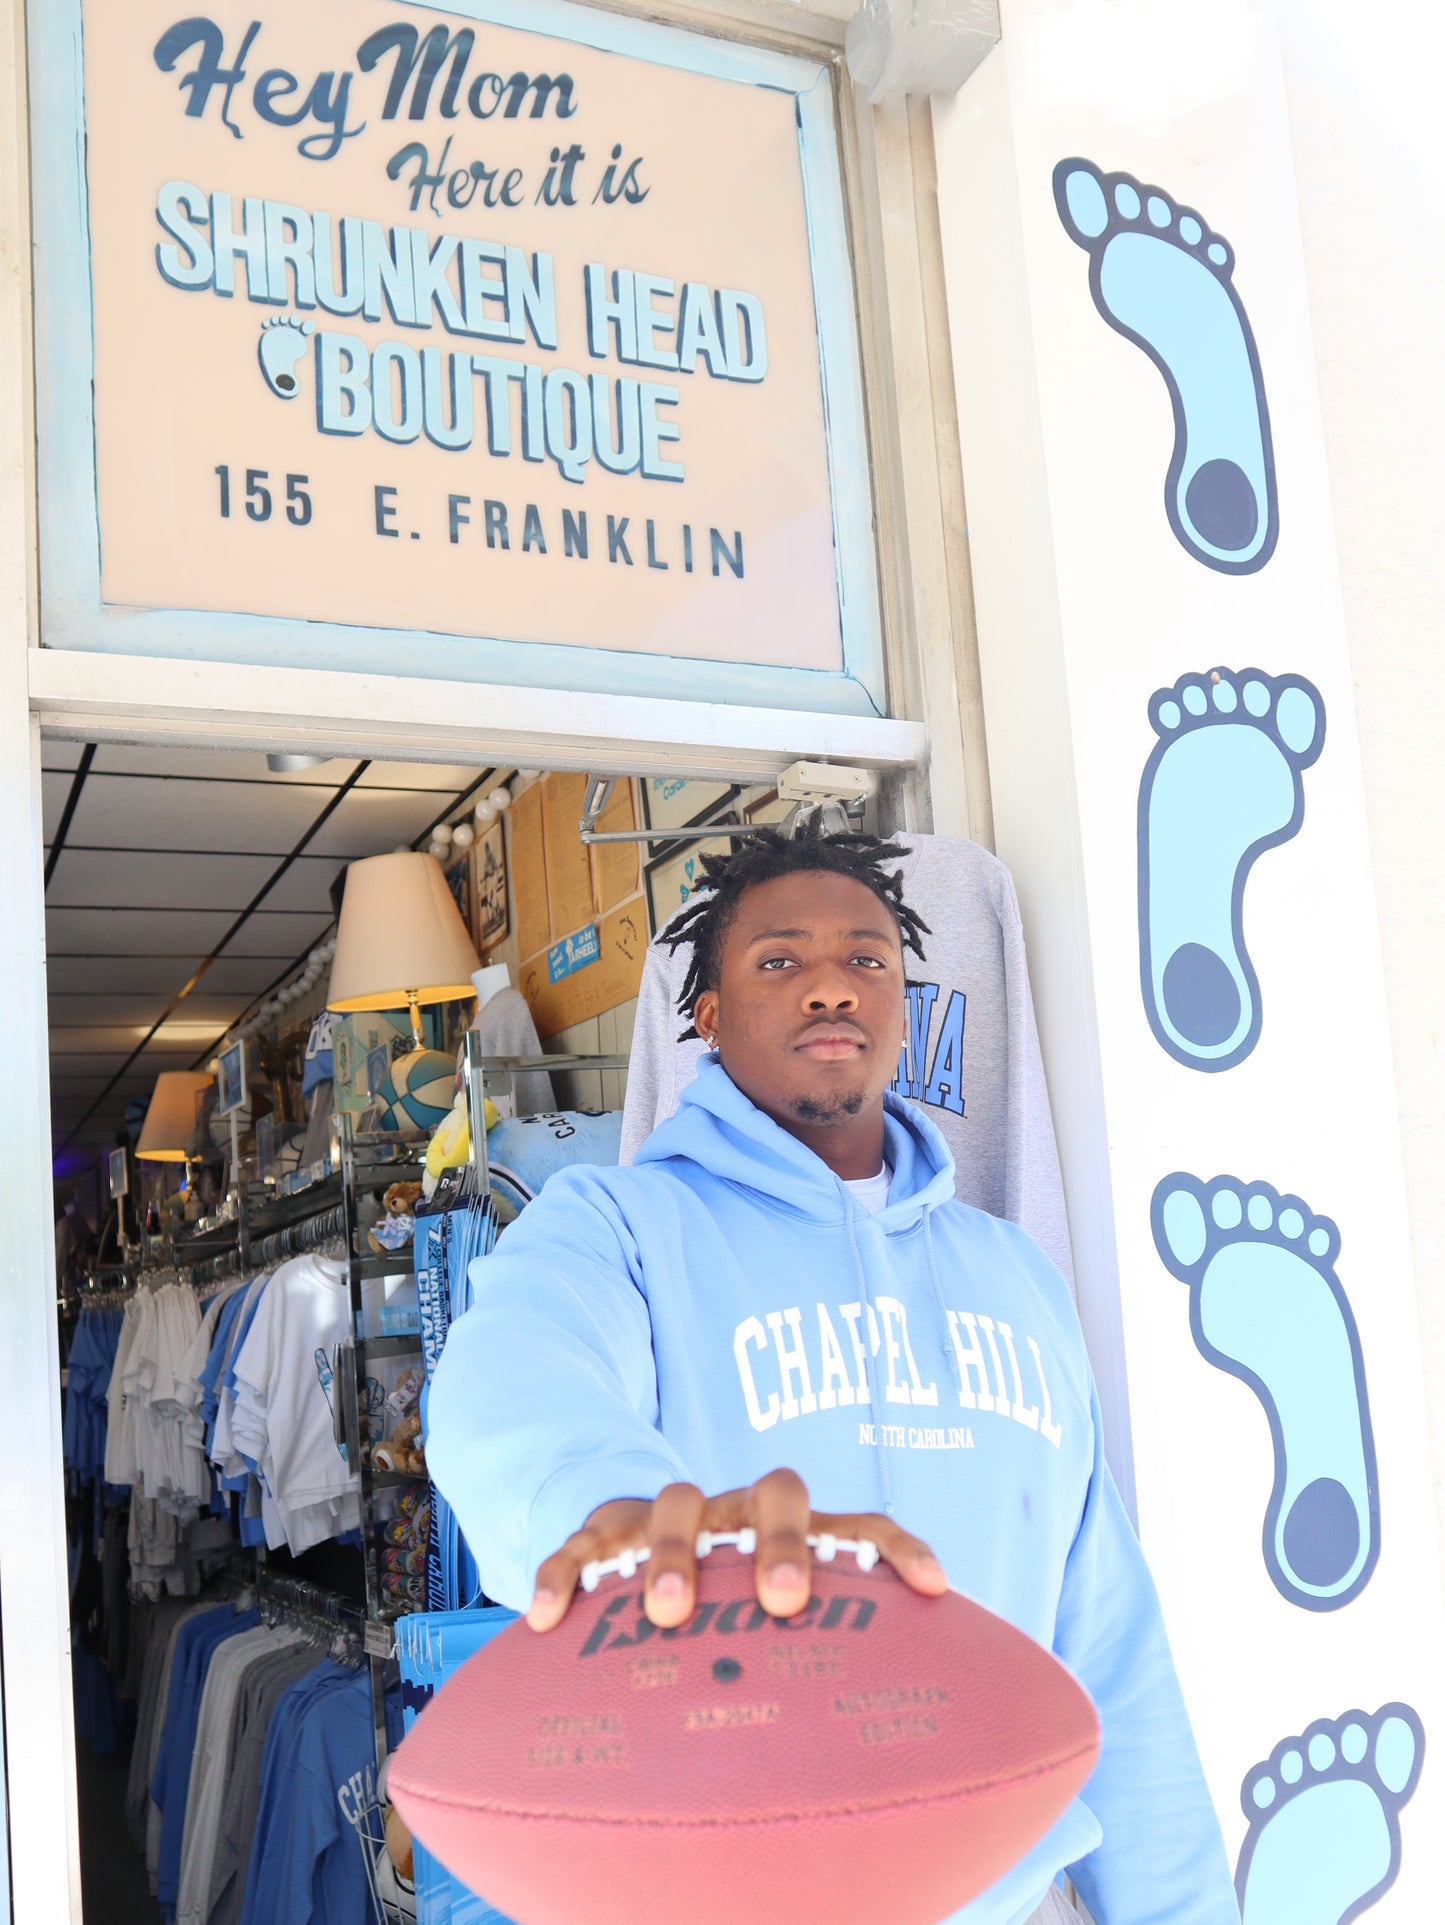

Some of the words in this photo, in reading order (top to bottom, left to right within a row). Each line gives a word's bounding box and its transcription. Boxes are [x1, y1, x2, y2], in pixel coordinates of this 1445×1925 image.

[153, 16, 367, 160] Hey
[357, 22, 579, 121] Mom
[386, 135, 525, 217] Here
[536, 143, 586, 207] it
[592, 143, 651, 207] is
[155, 179, 557, 351] SHRUNKEN
[585, 262, 768, 384] HEAD
[315, 331, 685, 484] BOUTIQUE
[214, 464, 313, 527] 155
[374, 485, 421, 541] E.
[447, 494, 745, 579] FRANKLIN
[429, 1266, 443, 1353] NATIONAL
[733, 1296, 939, 1433] CHAPEL
[945, 1310, 1063, 1449] HILL
[909, 1427, 975, 1449] CAROLINA
[338, 1761, 376, 1824] CHA
